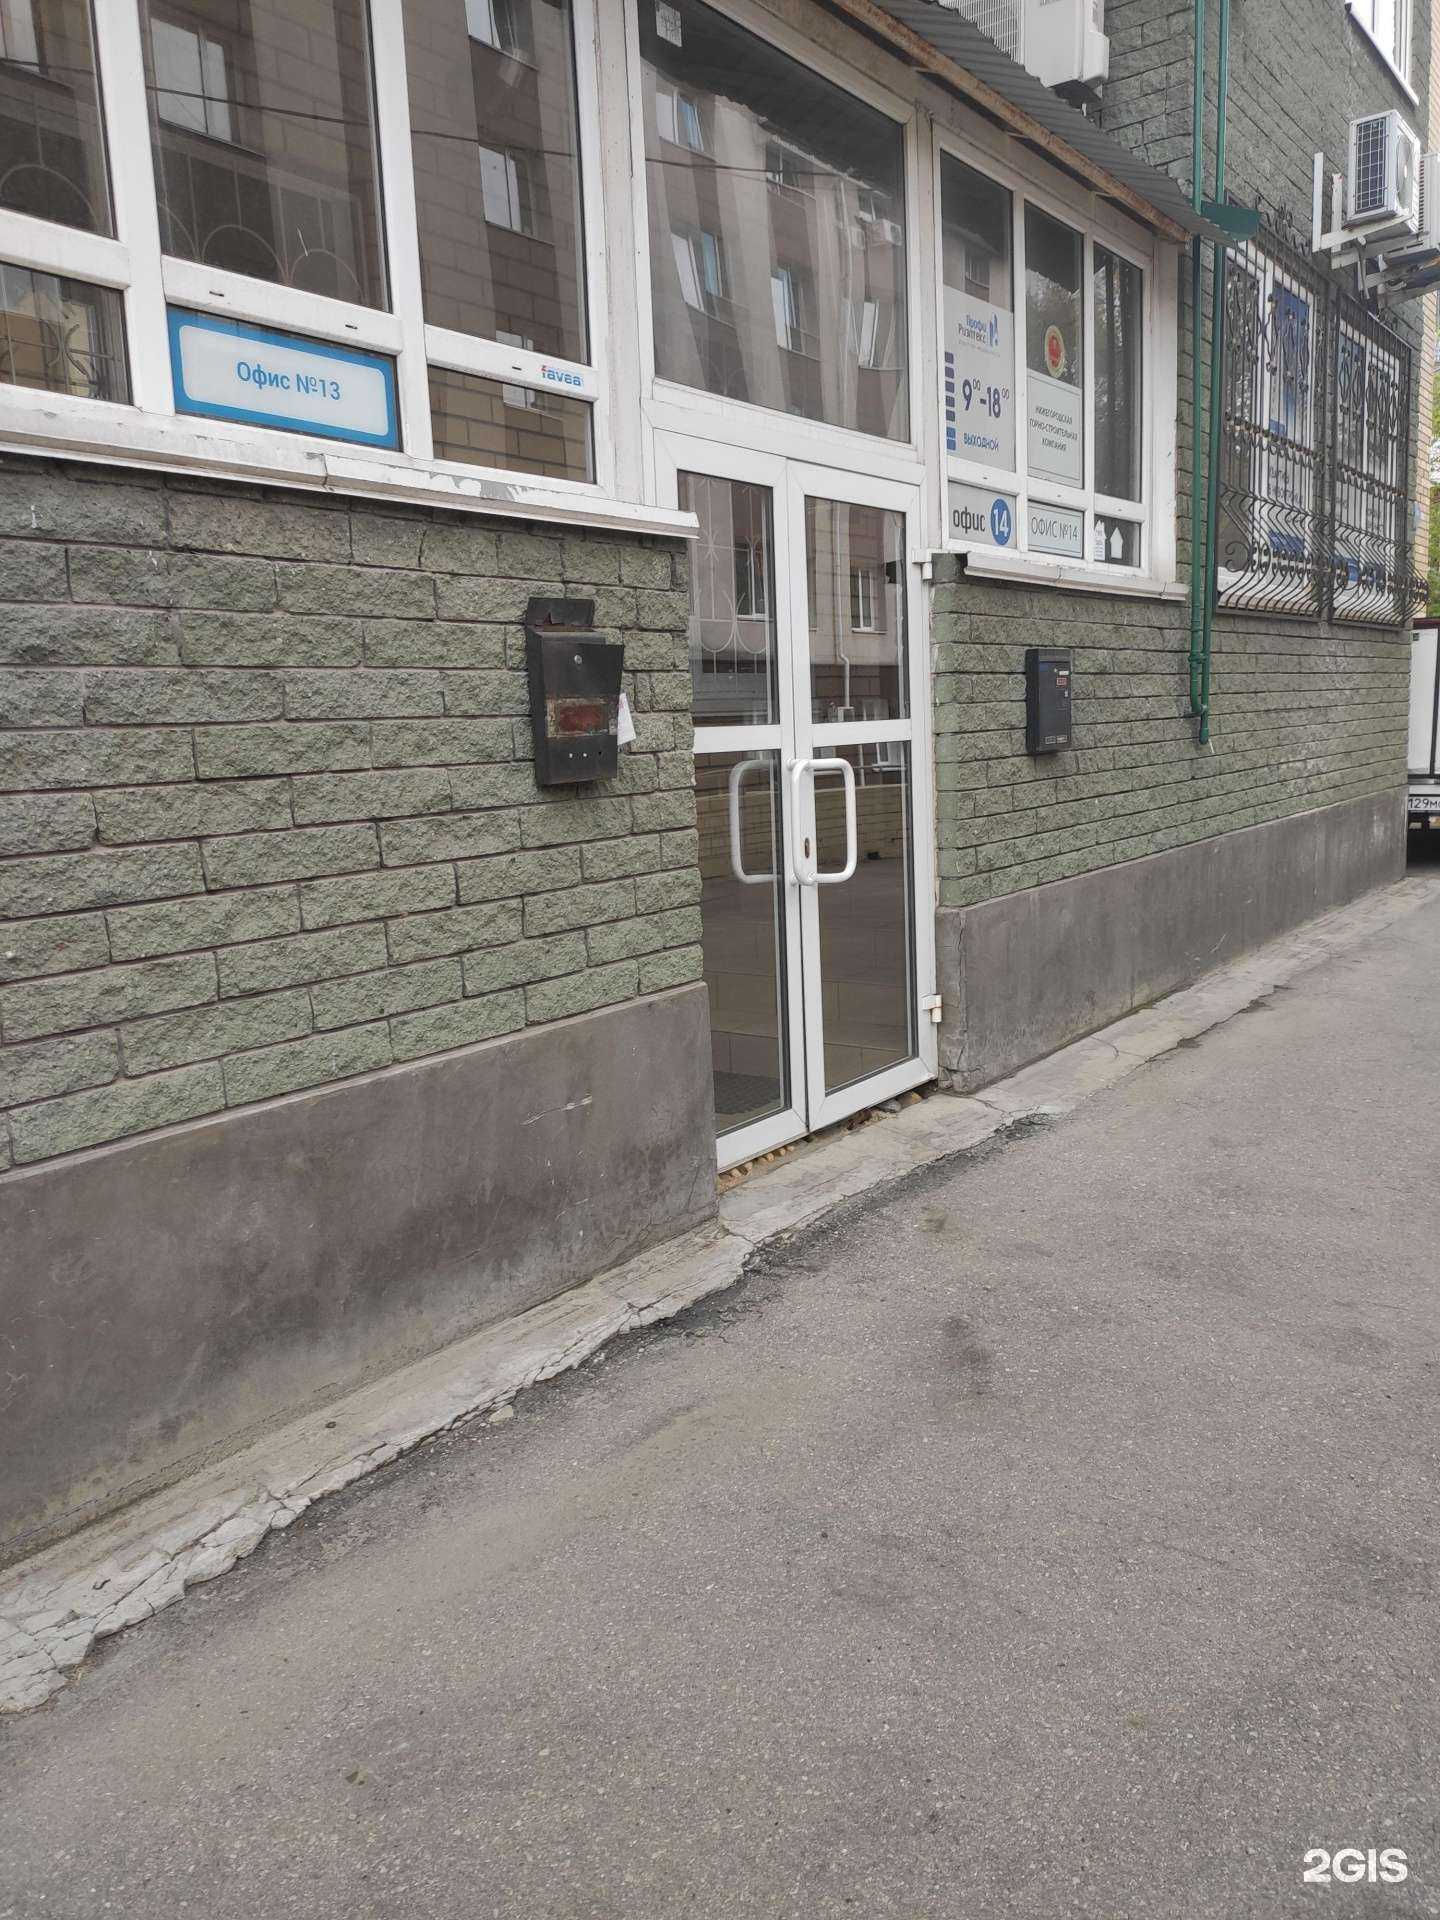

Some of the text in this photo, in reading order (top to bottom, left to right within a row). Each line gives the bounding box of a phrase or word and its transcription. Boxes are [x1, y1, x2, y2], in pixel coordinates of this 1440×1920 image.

[237, 361, 341, 401] Офис №13
[963, 432, 999, 451] ВЫХОДНОЙ
[953, 506, 1009, 537] офис 14
[1031, 516, 1079, 542] ОФИС №14
